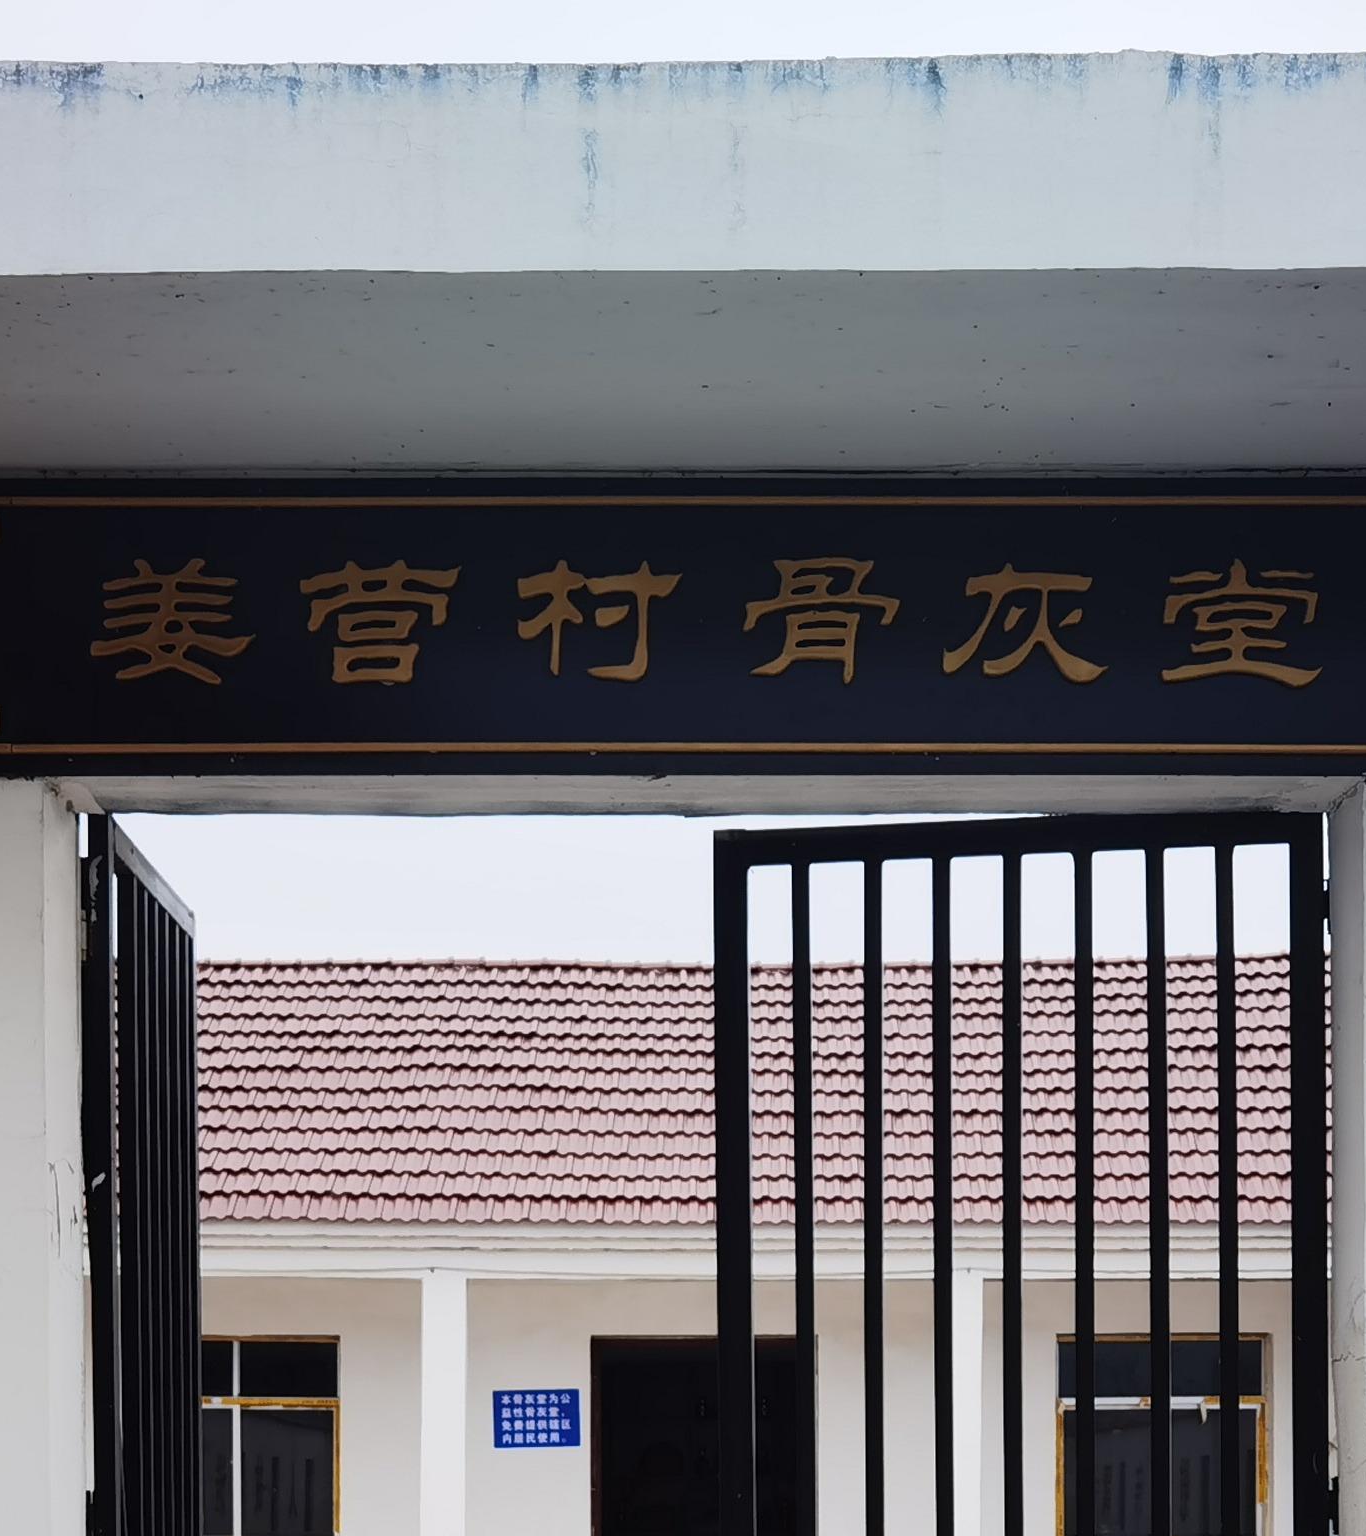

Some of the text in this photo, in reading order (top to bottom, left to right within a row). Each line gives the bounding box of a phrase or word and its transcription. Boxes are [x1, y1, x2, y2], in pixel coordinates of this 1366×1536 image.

[90, 557, 1323, 688] 姜营村骨灰堂
[501, 1393, 571, 1405] 本骨灰堂为公
